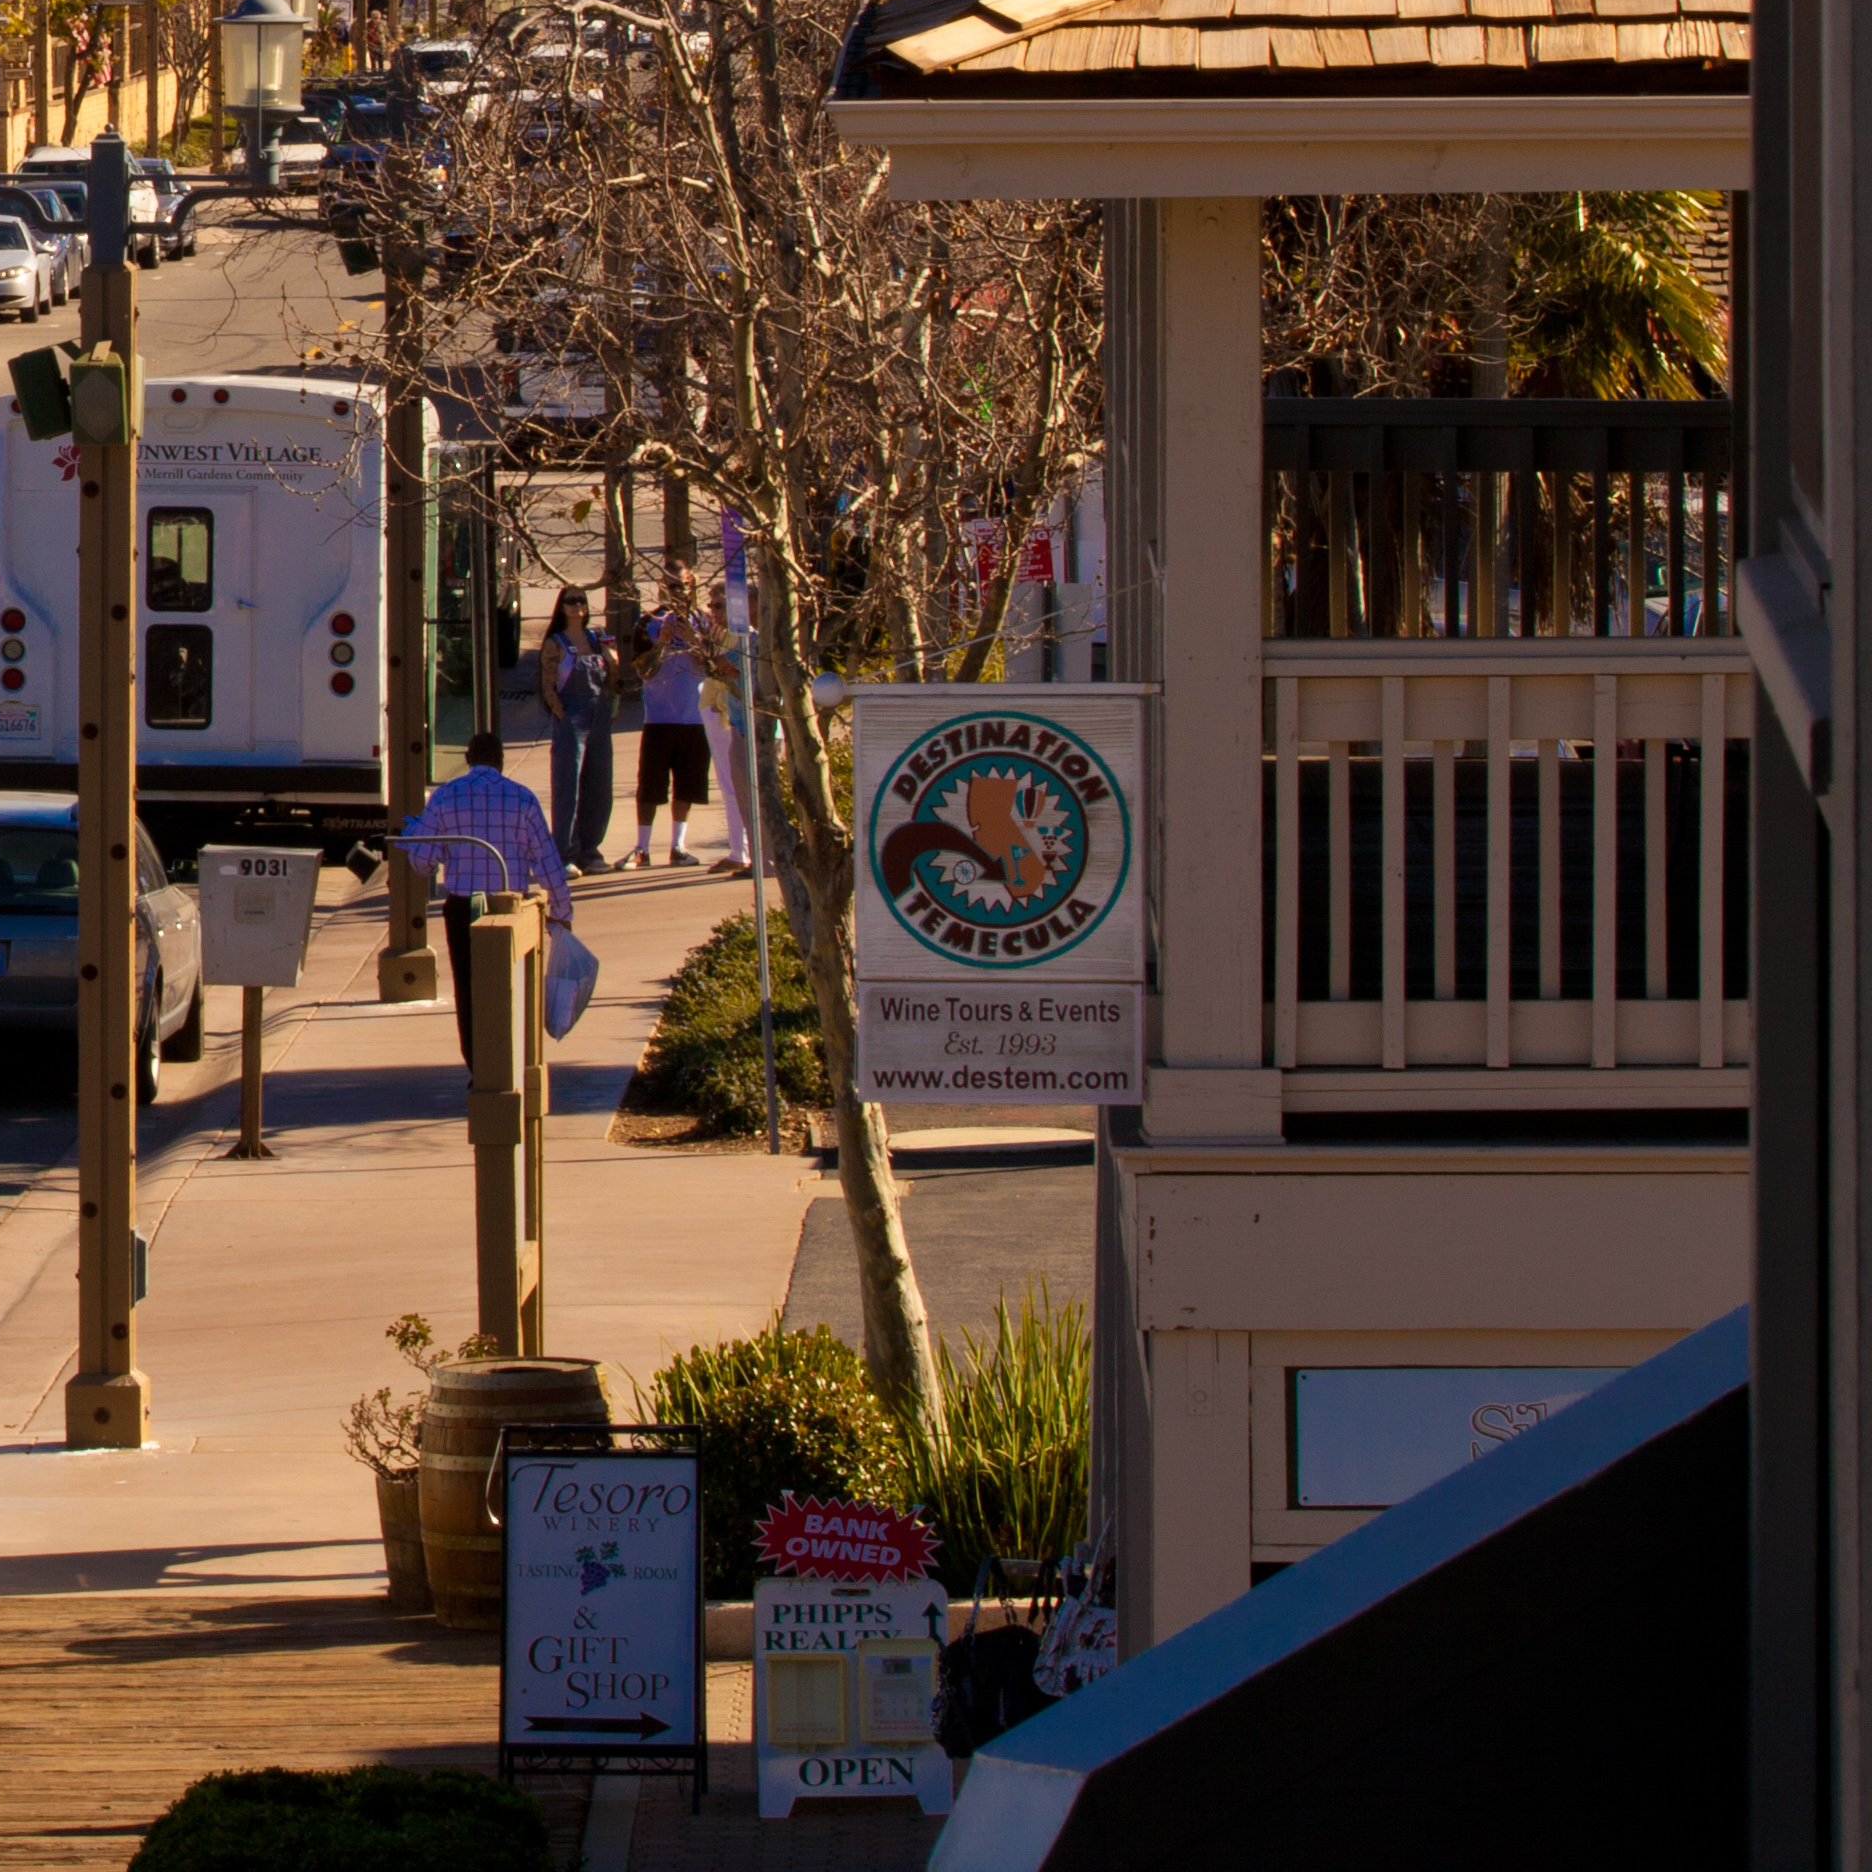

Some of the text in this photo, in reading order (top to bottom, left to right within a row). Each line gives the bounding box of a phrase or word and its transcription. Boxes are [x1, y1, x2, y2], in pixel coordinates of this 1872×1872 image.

[136, 442, 322, 463] UNWEST VILLAGE
[145, 467, 183, 480] Merrill
[187, 468, 233, 481] Gardens
[236, 469, 304, 484] Community
[892, 720, 1110, 805] DESTINATION
[240, 859, 288, 877] 9031
[905, 890, 1098, 957] TEMECULA
[880, 997, 1120, 1023] Wine Tours & Events
[944, 1030, 1057, 1056] Est. 1993
[873, 1065, 1128, 1091] www.destem.com
[511, 1462, 691, 1516] Tesoro
[543, 1515, 660, 1532] WINERY
[804, 1514, 890, 1542] BANK
[785, 1537, 902, 1566] OWNED
[515, 1563, 678, 1580] TASTING ROOM
[573, 1605, 598, 1630] &
[771, 1603, 892, 1624] PHIPPS
[528, 1635, 629, 1674] GIFT
[565, 1671, 670, 1709] SHOP
[798, 1757, 914, 1787] OPEN
